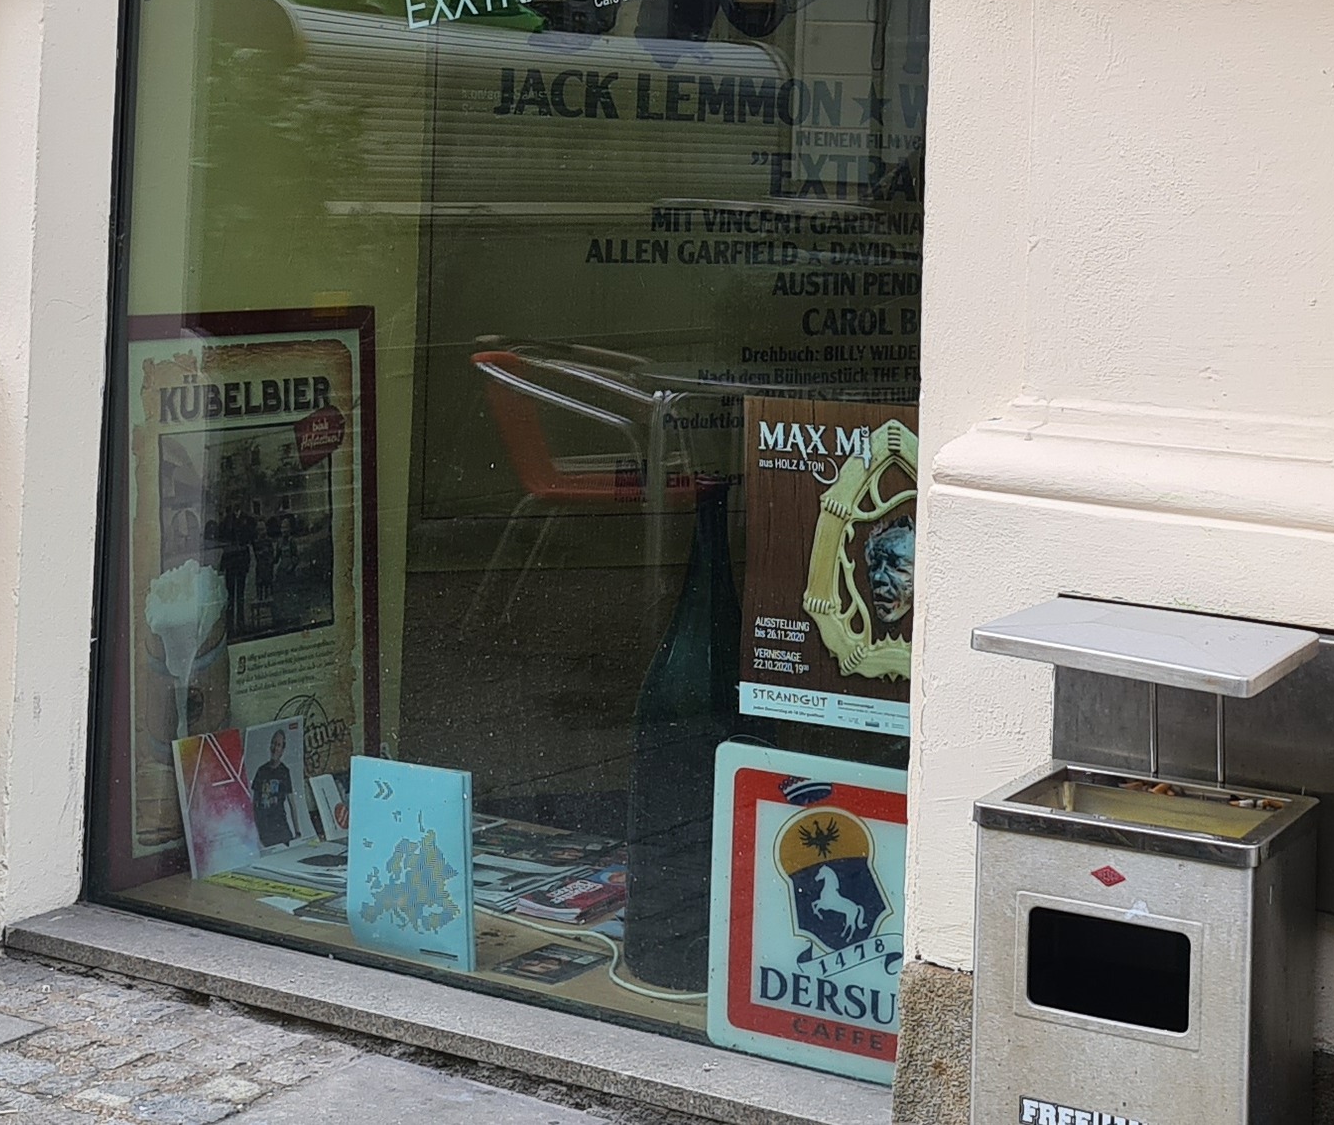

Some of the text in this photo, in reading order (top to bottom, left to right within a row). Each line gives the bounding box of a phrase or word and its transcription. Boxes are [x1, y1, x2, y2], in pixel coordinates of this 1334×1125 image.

[493, 67, 620, 120] JACK
[635, 72, 843, 127] LEMMON
[796, 130, 811, 146] IN
[817, 131, 862, 149] EINEM
[867, 133, 901, 150] FILM
[651, 208, 694, 233] MIT
[703, 209, 805, 235] VINCENT
[585, 238, 669, 264] ALLEN
[677, 239, 800, 265] GARFIELD
[830, 241, 897, 266] DAVID
[771, 272, 857, 297] AUSTIN
[802, 307, 894, 337] CAROL
[741, 346, 818, 364] Drehbuch:
[823, 345, 866, 362] BILLY
[698, 369, 735, 386] Nach
[773, 368, 868, 386] Bühnenstück
[871, 366, 901, 384] THE
[159, 374, 332, 423] KÜBELBIER
[758, 421, 828, 461] MAX
[759, 458, 825, 473] aus HOLZ & TON
[754, 628, 766, 638] bis
[755, 616, 810, 632] AUSSTELLUNG
[753, 647, 803, 662] VERNISSAGE
[752, 688, 828, 708] STRANDGUT
[819, 938, 886, 976] 1478
[759, 966, 896, 1025] DERSU
